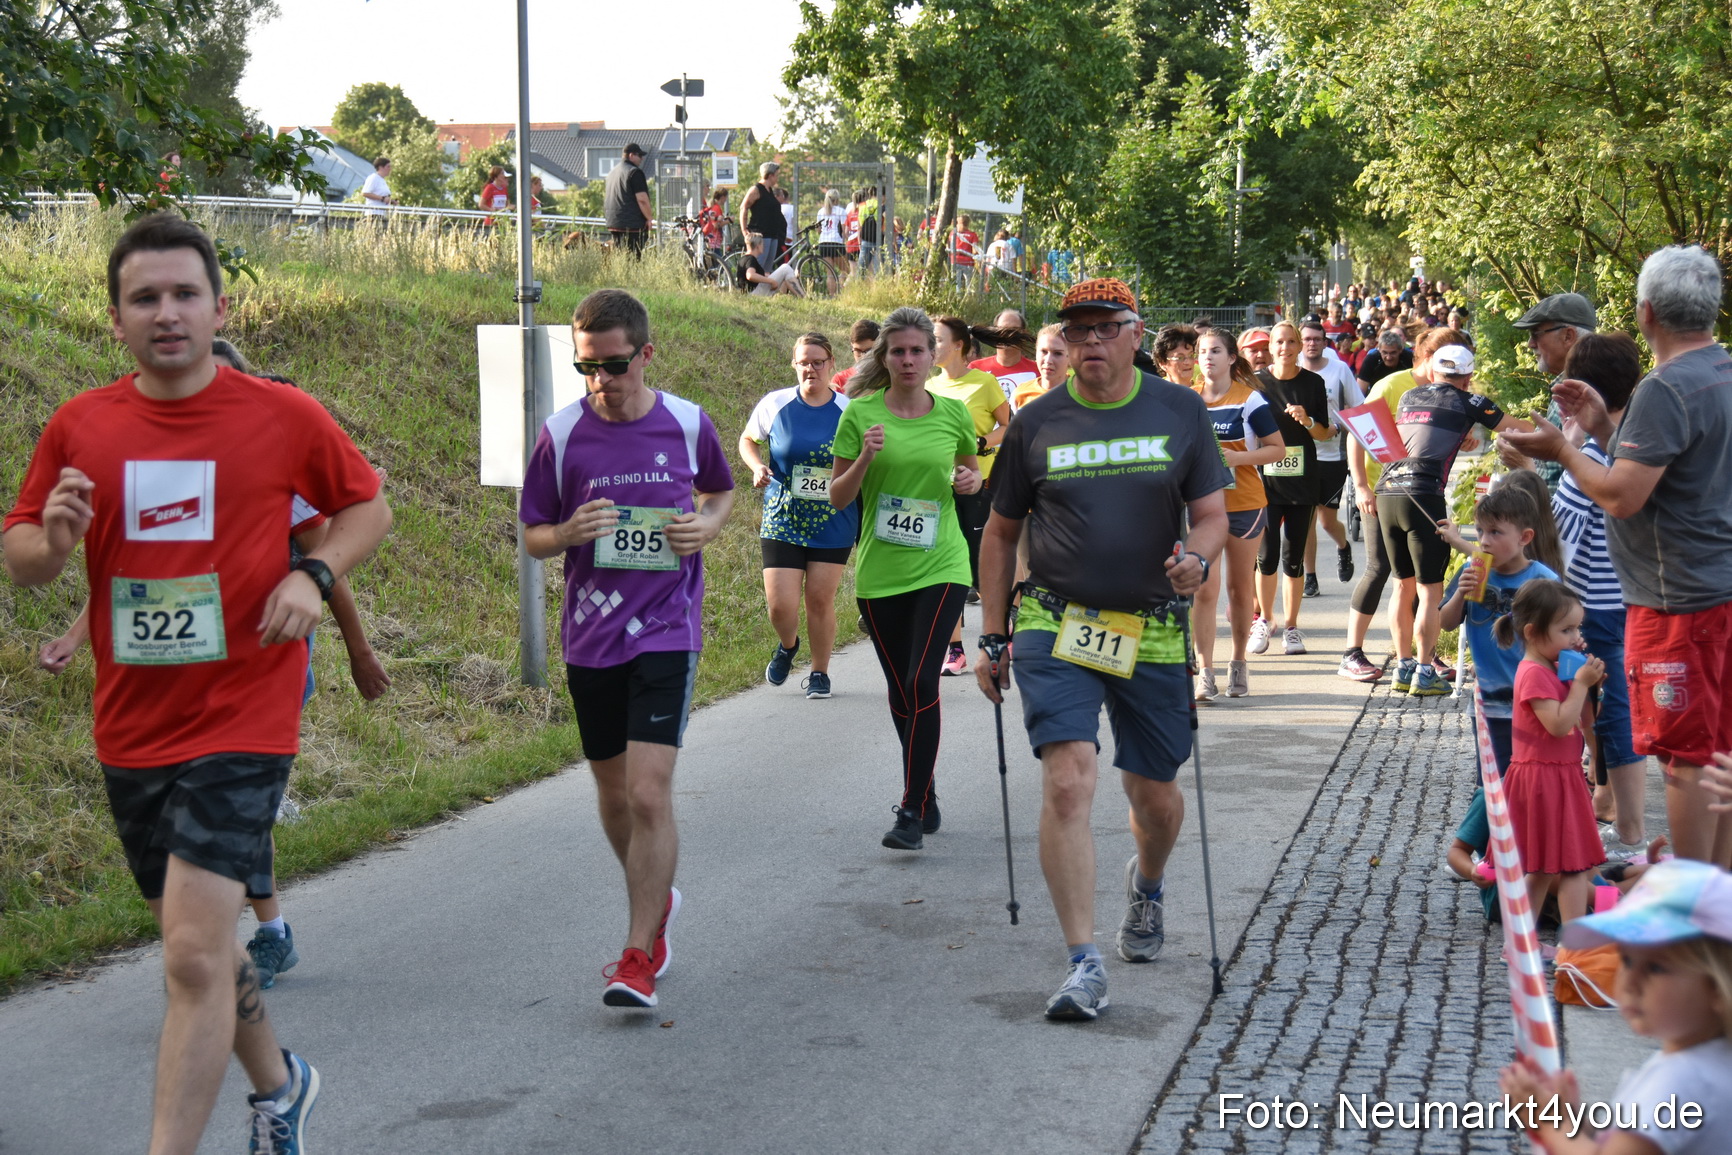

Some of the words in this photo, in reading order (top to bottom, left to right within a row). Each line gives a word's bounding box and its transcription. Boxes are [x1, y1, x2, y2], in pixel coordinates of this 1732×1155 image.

[1048, 437, 1172, 472] BOCK
[589, 476, 610, 489] WIR
[613, 473, 641, 485] SIND
[644, 472, 674, 483] LILA.
[1047, 470, 1082, 481] inspired
[1084, 469, 1096, 478] by
[1098, 467, 1125, 476] smart
[1126, 463, 1167, 474] concepts
[801, 478, 827, 491] 264
[155, 506, 184, 522] DEHN
[887, 513, 924, 534] 446
[614, 529, 662, 553] 895
[133, 609, 196, 641] 522
[128, 642, 177, 651] Moosburger
[180, 640, 207, 648] Bernd
[1076, 625, 1122, 656] 311
[1069, 645, 1100, 659] Lehmeyer
[1101, 654, 1122, 665] Jürgen
